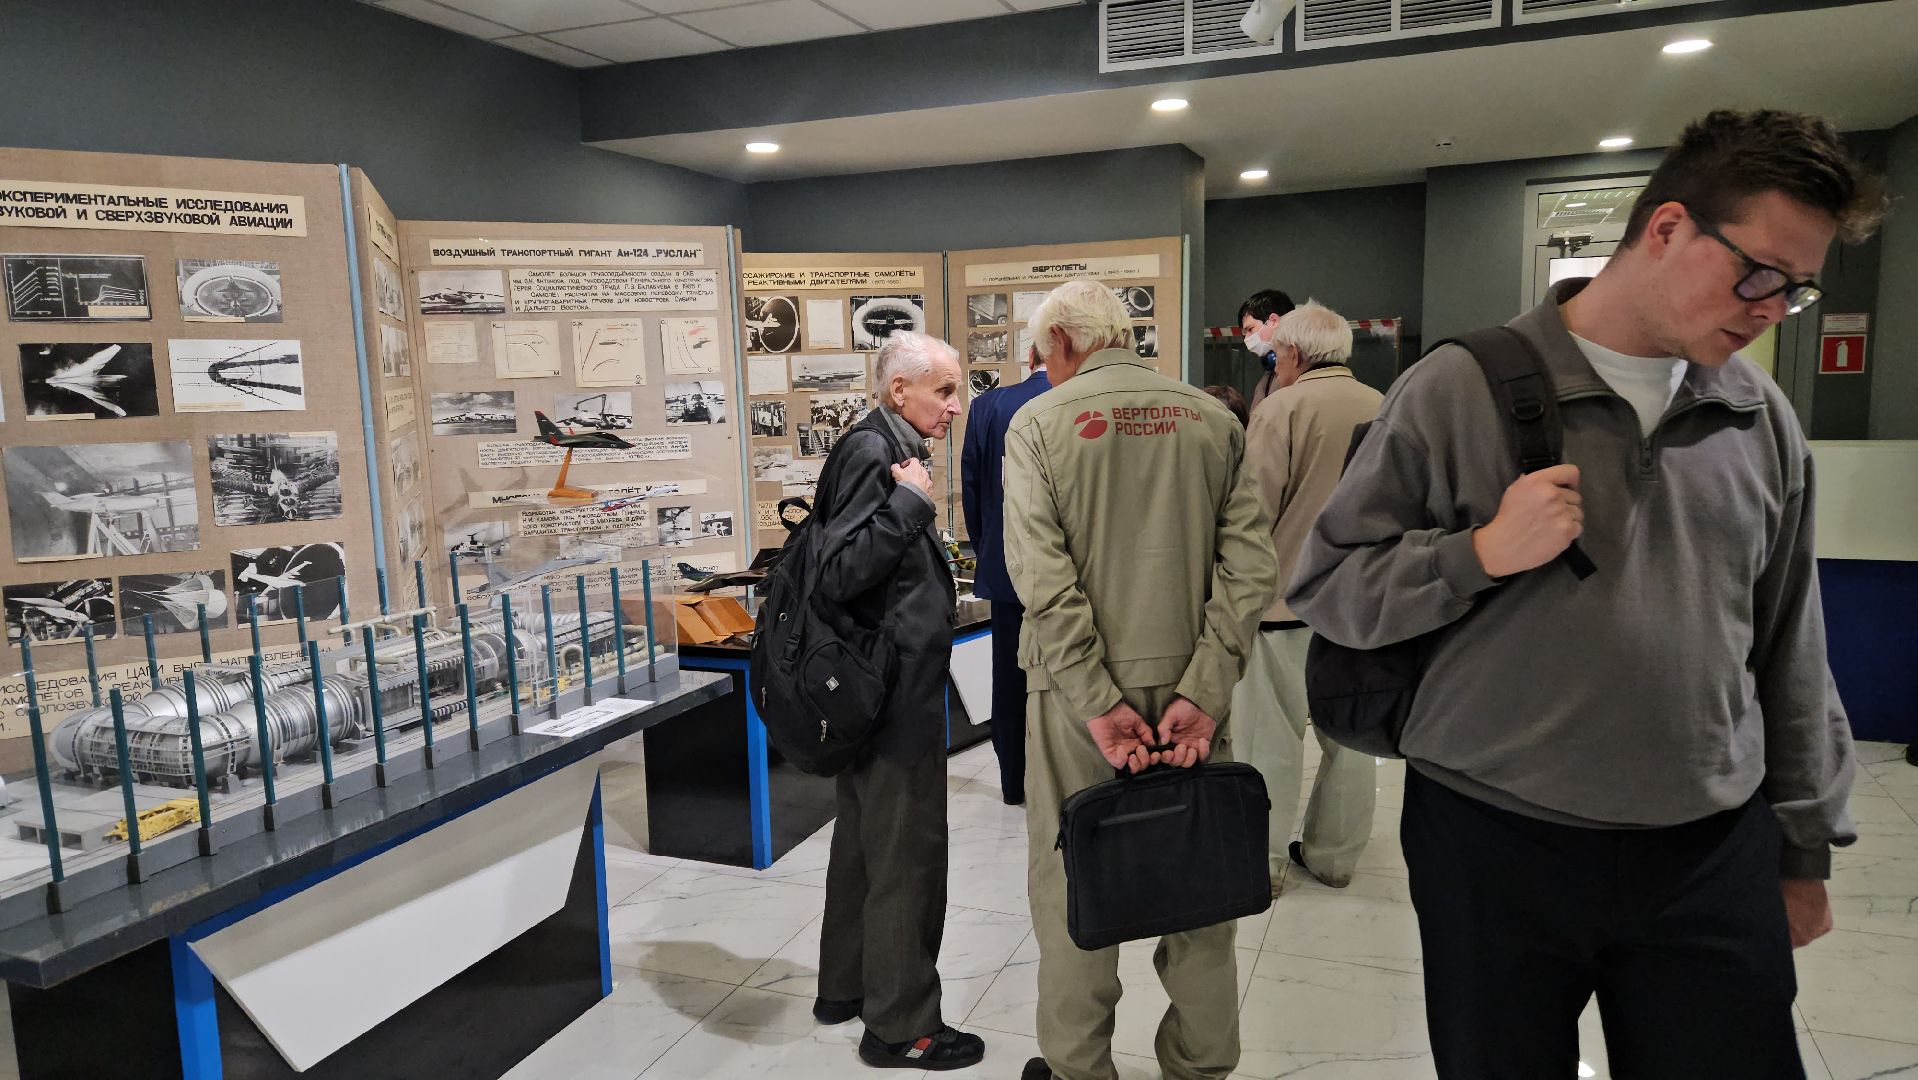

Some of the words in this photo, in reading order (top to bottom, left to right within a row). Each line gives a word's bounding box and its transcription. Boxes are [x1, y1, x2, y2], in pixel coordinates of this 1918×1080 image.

[0, 190, 168, 208] КСПЕРИМЕНТАЛЬНЫЕ
[175, 198, 289, 214] ИССЛЕДОВАНИЯ
[76, 208, 88, 220] И
[95, 209, 220, 226] СВЕРХЗВУКОВОЙ
[229, 215, 293, 230] АВИАЦИИ
[432, 247, 496, 258] ВОЗДУШНЫЙ
[500, 247, 574, 257] ТРАНСПОРТНЫЙ
[578, 249, 612, 258] ГИГАНТ
[809, 278, 868, 287] ДВИГАТЕЛЯМИ
[1111, 406, 1203, 422] ВЕРТОЛЕТЫ
[1115, 420, 1177, 436] РОССИИ
